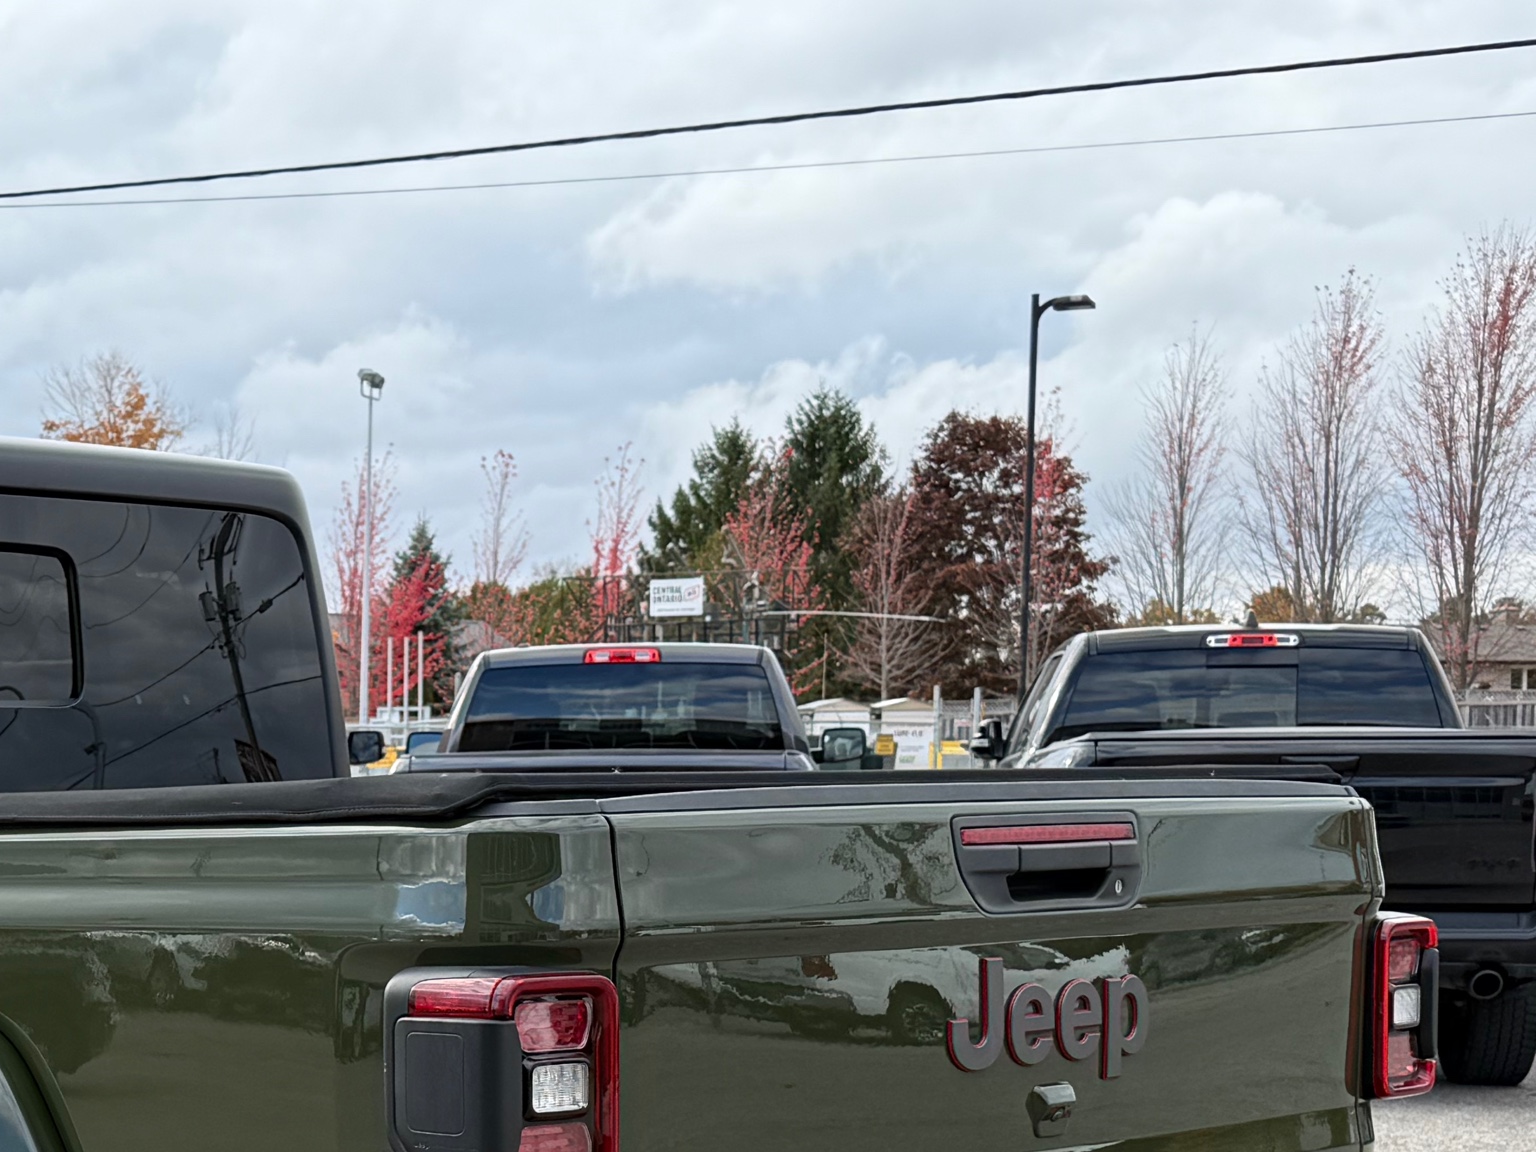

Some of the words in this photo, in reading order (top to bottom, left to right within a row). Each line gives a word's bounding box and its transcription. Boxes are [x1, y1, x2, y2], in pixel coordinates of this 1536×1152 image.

[652, 586, 682, 595] CENTRAL
[652, 594, 683, 604] ONTARIO
[946, 956, 1150, 1081] Jeep
